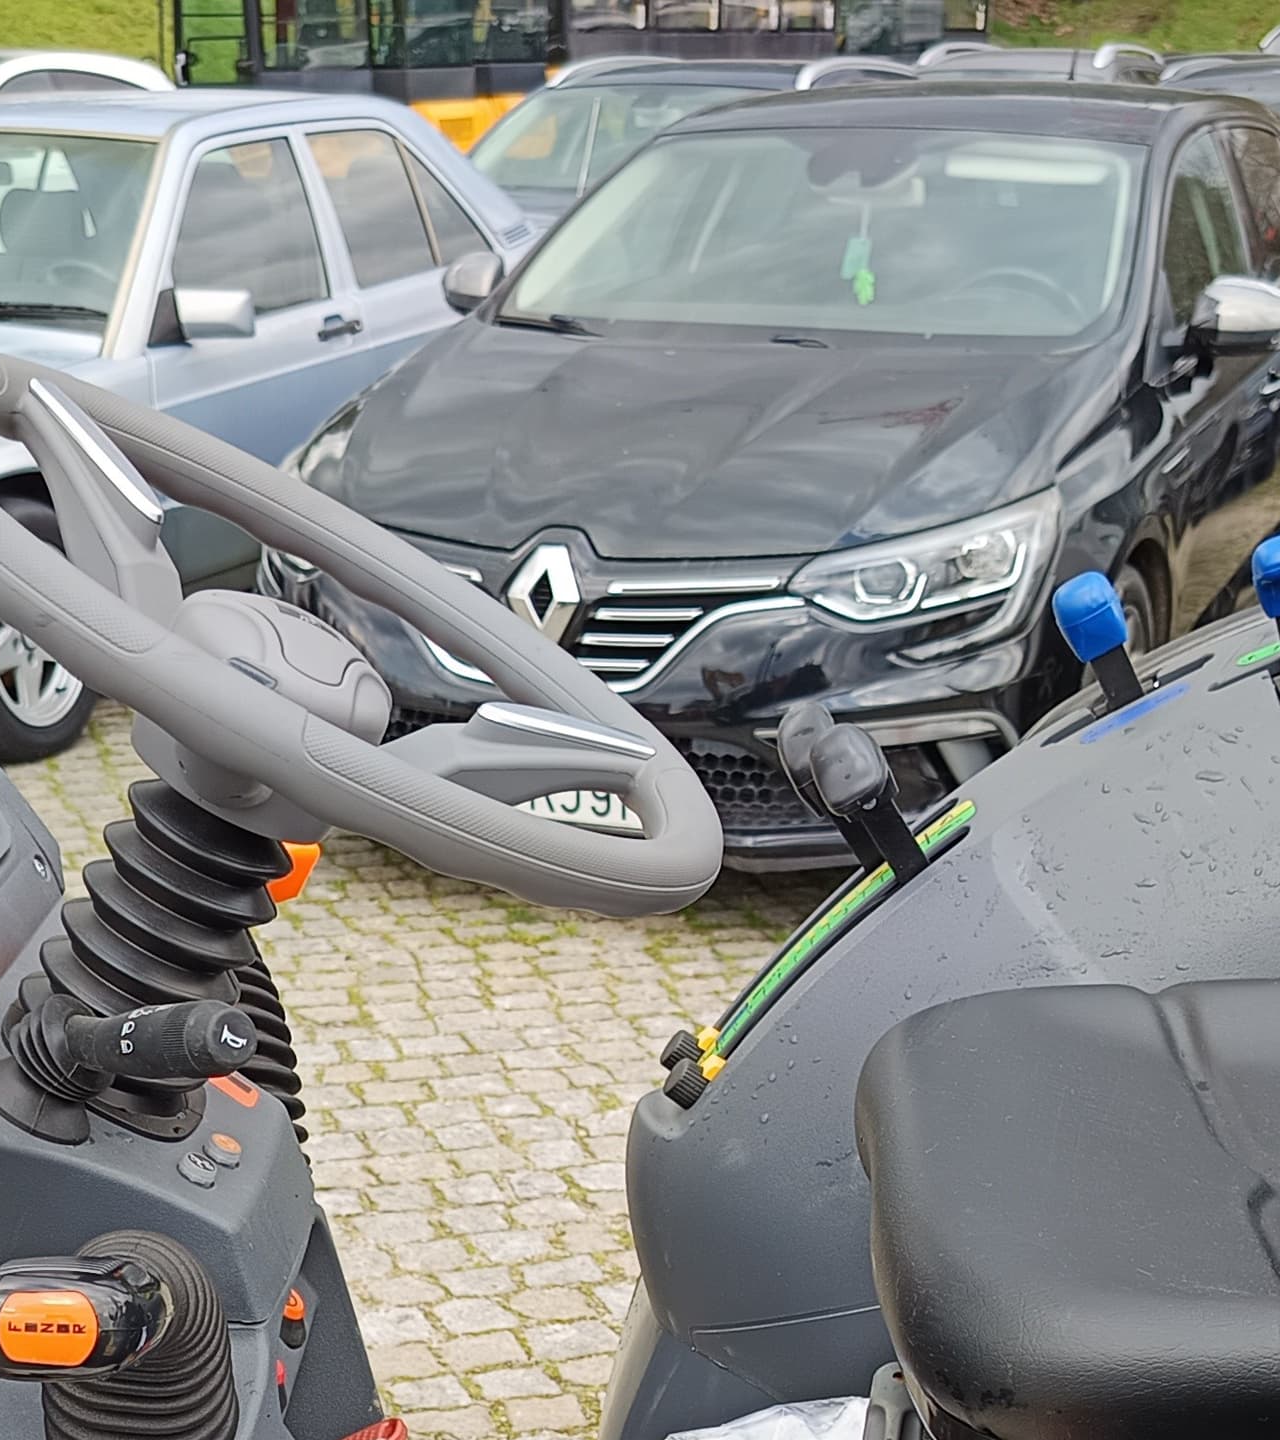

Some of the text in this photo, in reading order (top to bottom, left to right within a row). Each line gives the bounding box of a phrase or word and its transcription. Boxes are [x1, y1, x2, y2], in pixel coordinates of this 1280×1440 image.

[7, 1321, 87, 1334] F N R
